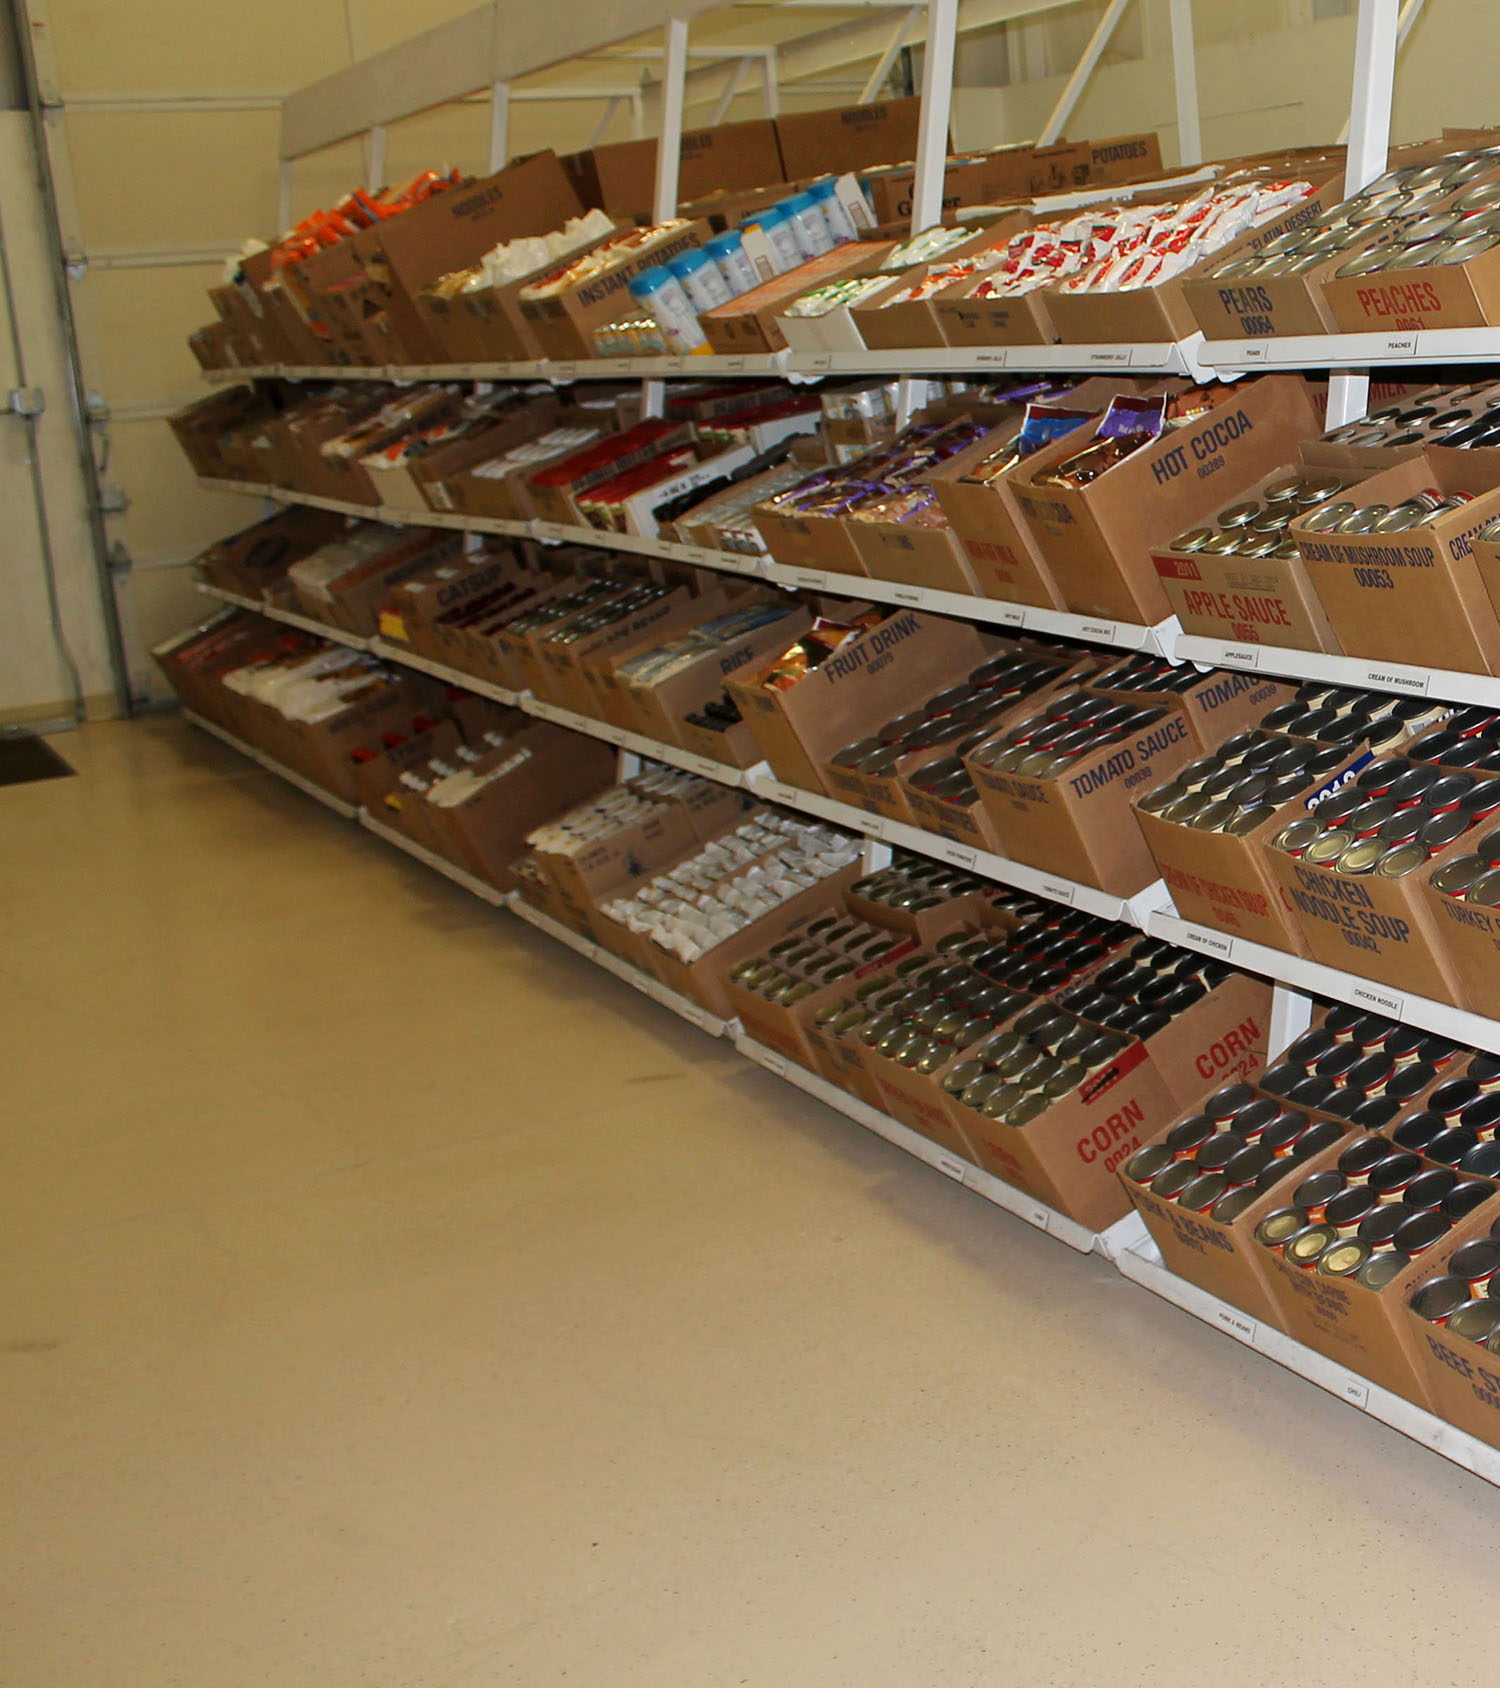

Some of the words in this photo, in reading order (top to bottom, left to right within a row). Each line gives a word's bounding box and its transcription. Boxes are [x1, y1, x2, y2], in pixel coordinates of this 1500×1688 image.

[1091, 140, 1148, 165] POTATOES
[1284, 200, 1323, 235] DESSERT
[576, 266, 634, 308] INSTANT
[1218, 285, 1274, 315] PEARS
[1356, 282, 1442, 318] PEACHES
[1150, 445, 1188, 486] HOT
[1189, 410, 1254, 461] COCOA
[1197, 456, 1225, 479] 00289
[1174, 560, 1200, 578] 2011
[1300, 541, 1332, 563] CREAM
[1333, 545, 1346, 565] OF
[1347, 545, 1408, 568] MUSHROOM
[1405, 547, 1435, 569] SOUP
[1353, 567, 1395, 589] 00053
[1183, 589, 1231, 620] APPLE
[1232, 594, 1292, 627] SAUCE
[822, 642, 866, 685] FRUIT
[869, 612, 921, 658] DRINK
[1069, 749, 1135, 799] TOMATO
[1136, 716, 1189, 763] SAUCE
[1294, 866, 1375, 910] CHICKEN
[1289, 886, 1361, 931] NOODLE
[1358, 910, 1410, 944] SOUP
[1441, 900, 1494, 934] TURKEY
[1354, 988, 1376, 1003] CHICKEN
[1376, 996, 1398, 1010] NOODLE
[1195, 1016, 1262, 1080] CORN
[1076, 1099, 1146, 1165] CORN
[1425, 1333, 1474, 1381] BEEF
